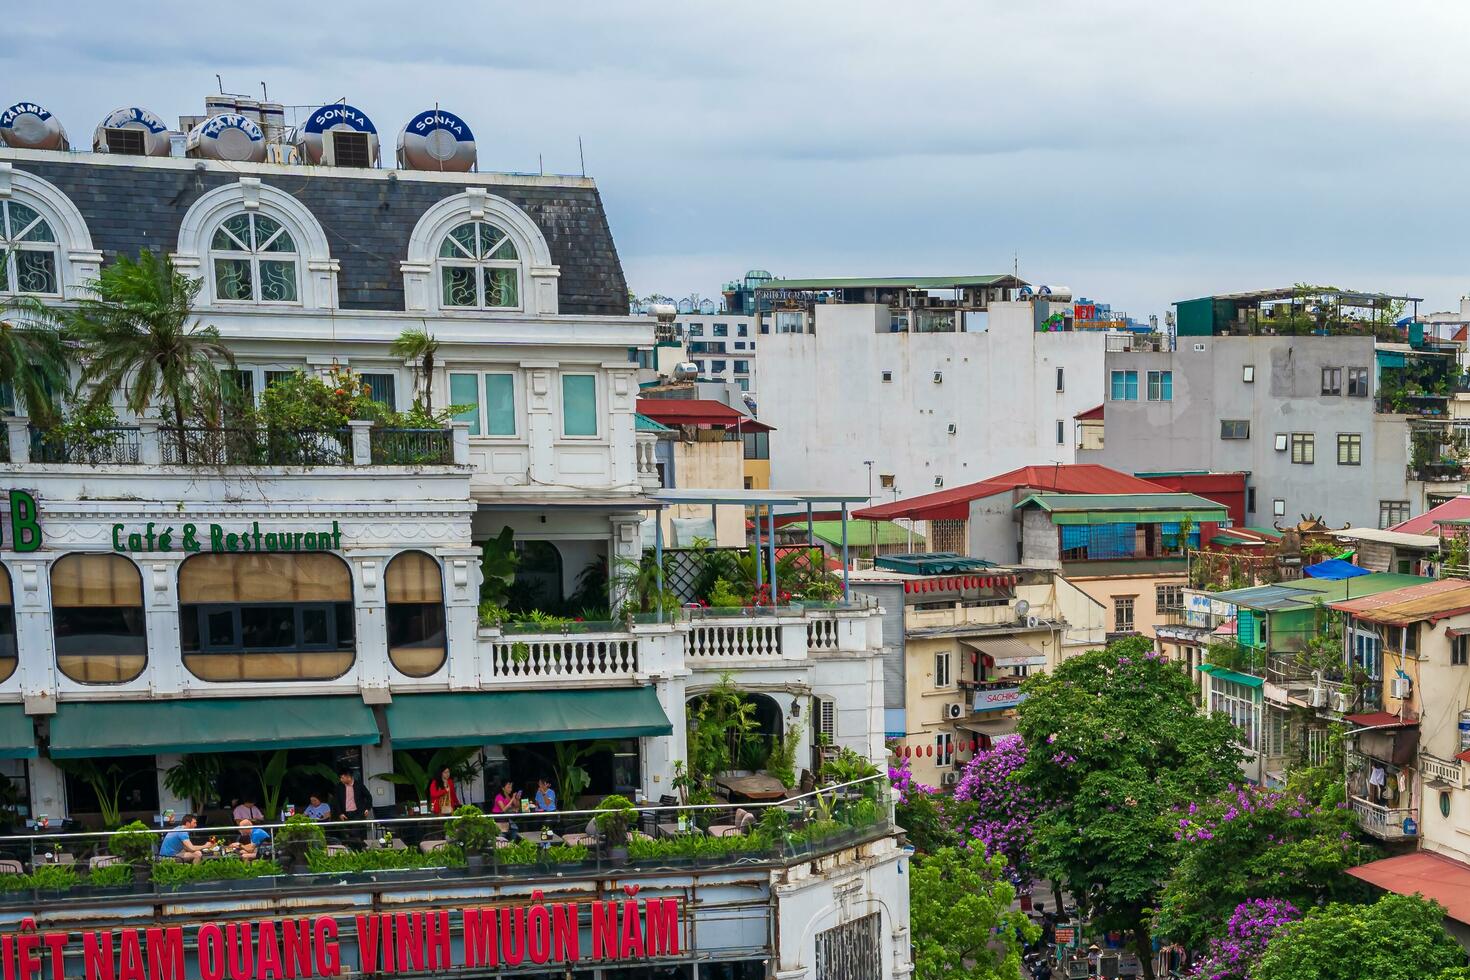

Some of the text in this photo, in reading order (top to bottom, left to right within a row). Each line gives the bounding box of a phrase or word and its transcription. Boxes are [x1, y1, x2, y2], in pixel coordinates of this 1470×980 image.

[316, 108, 364, 127] SONHA
[415, 115, 463, 135] SONHA
[112, 520, 342, 552] Café & Restaurant
[355, 910, 450, 974] VINH
[463, 889, 580, 967] MUÔN
[591, 884, 680, 961] NĂM
